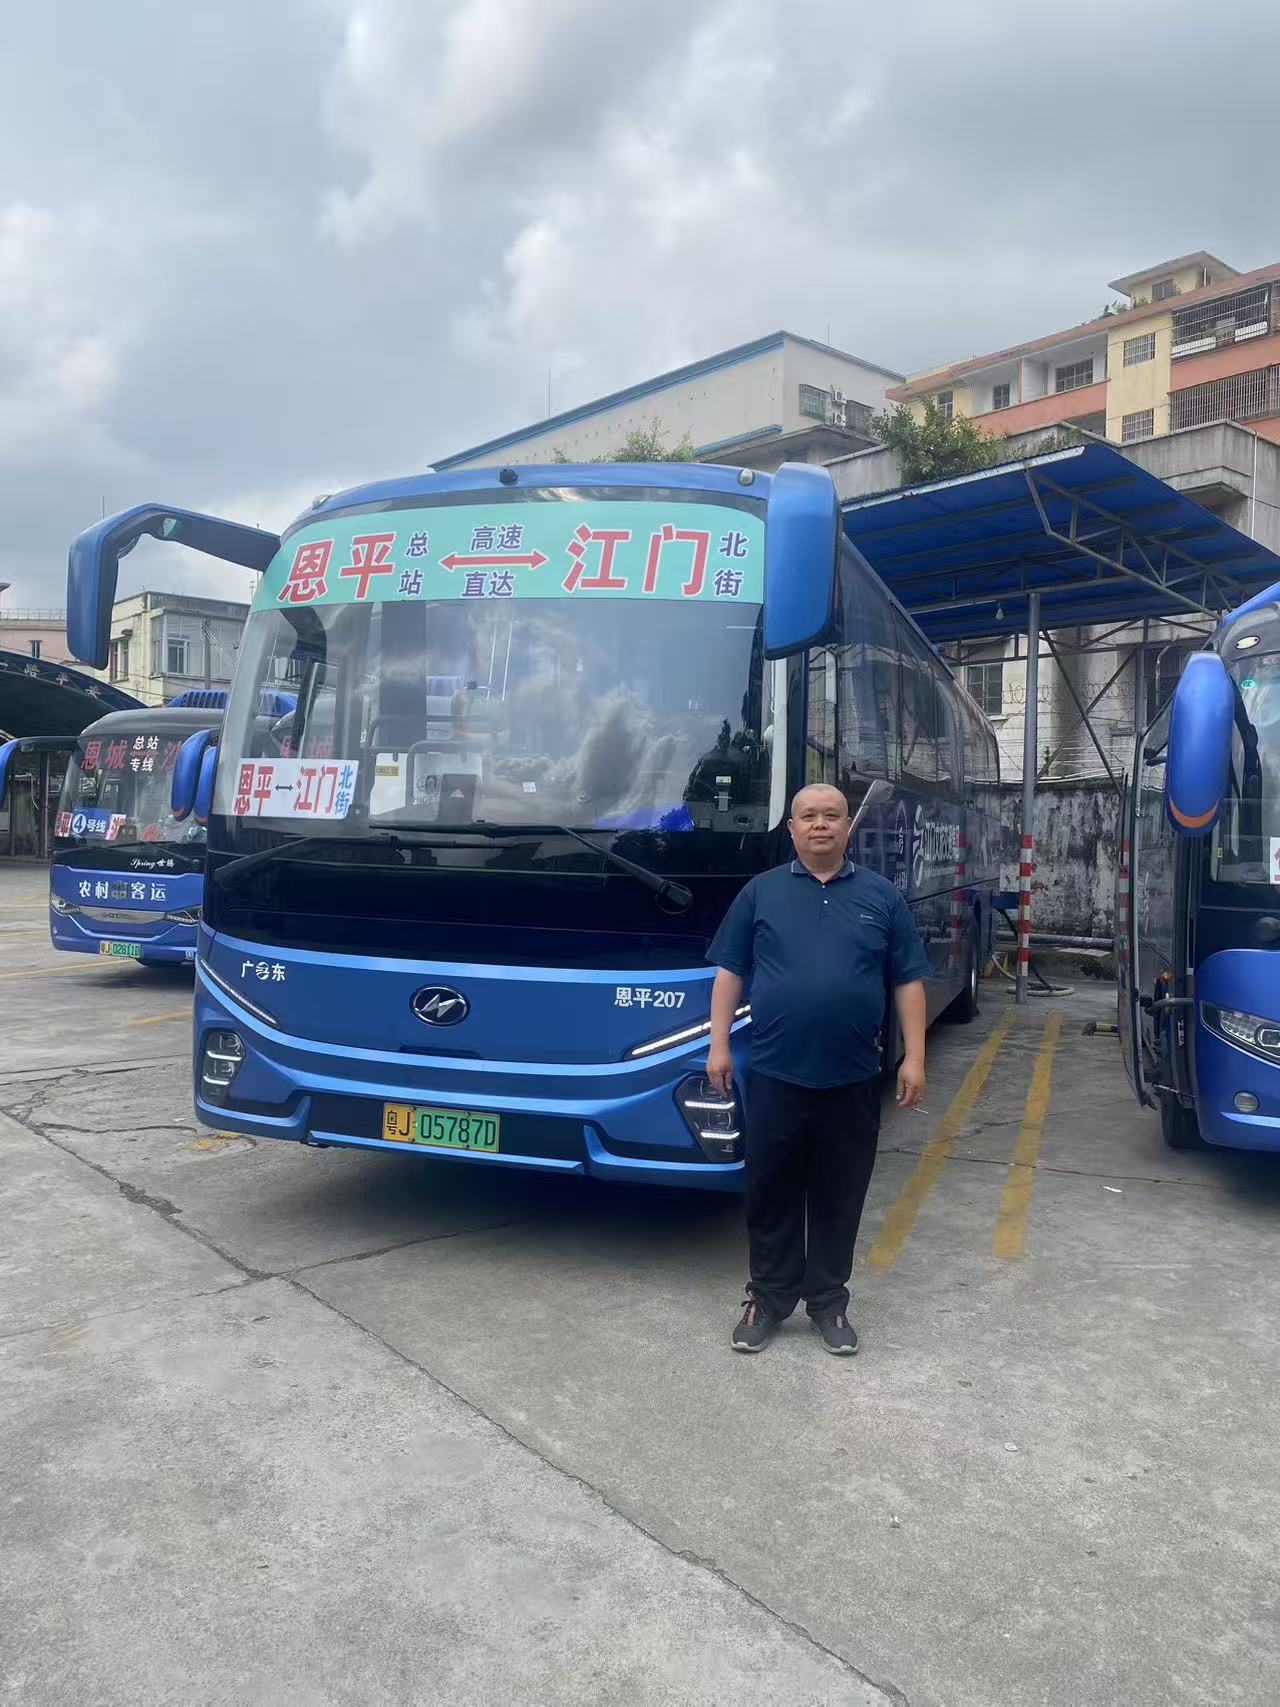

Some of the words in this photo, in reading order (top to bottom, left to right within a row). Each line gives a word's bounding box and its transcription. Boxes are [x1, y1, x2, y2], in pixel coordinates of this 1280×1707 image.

[470, 524, 525, 551] 高速
[276, 531, 399, 604] 恩平
[561, 522, 713, 597] 江门
[713, 531, 751, 598] 北街
[461, 570, 516, 599] 直达
[133, 735, 160, 750] 总站
[130, 757, 154, 772] 专线
[233, 763, 275, 817] 恩平
[293, 765, 340, 815] 江门
[78, 880, 110, 900] 农村
[130, 882, 167, 902] 客运
[613, 987, 687, 1010] 恩平207
